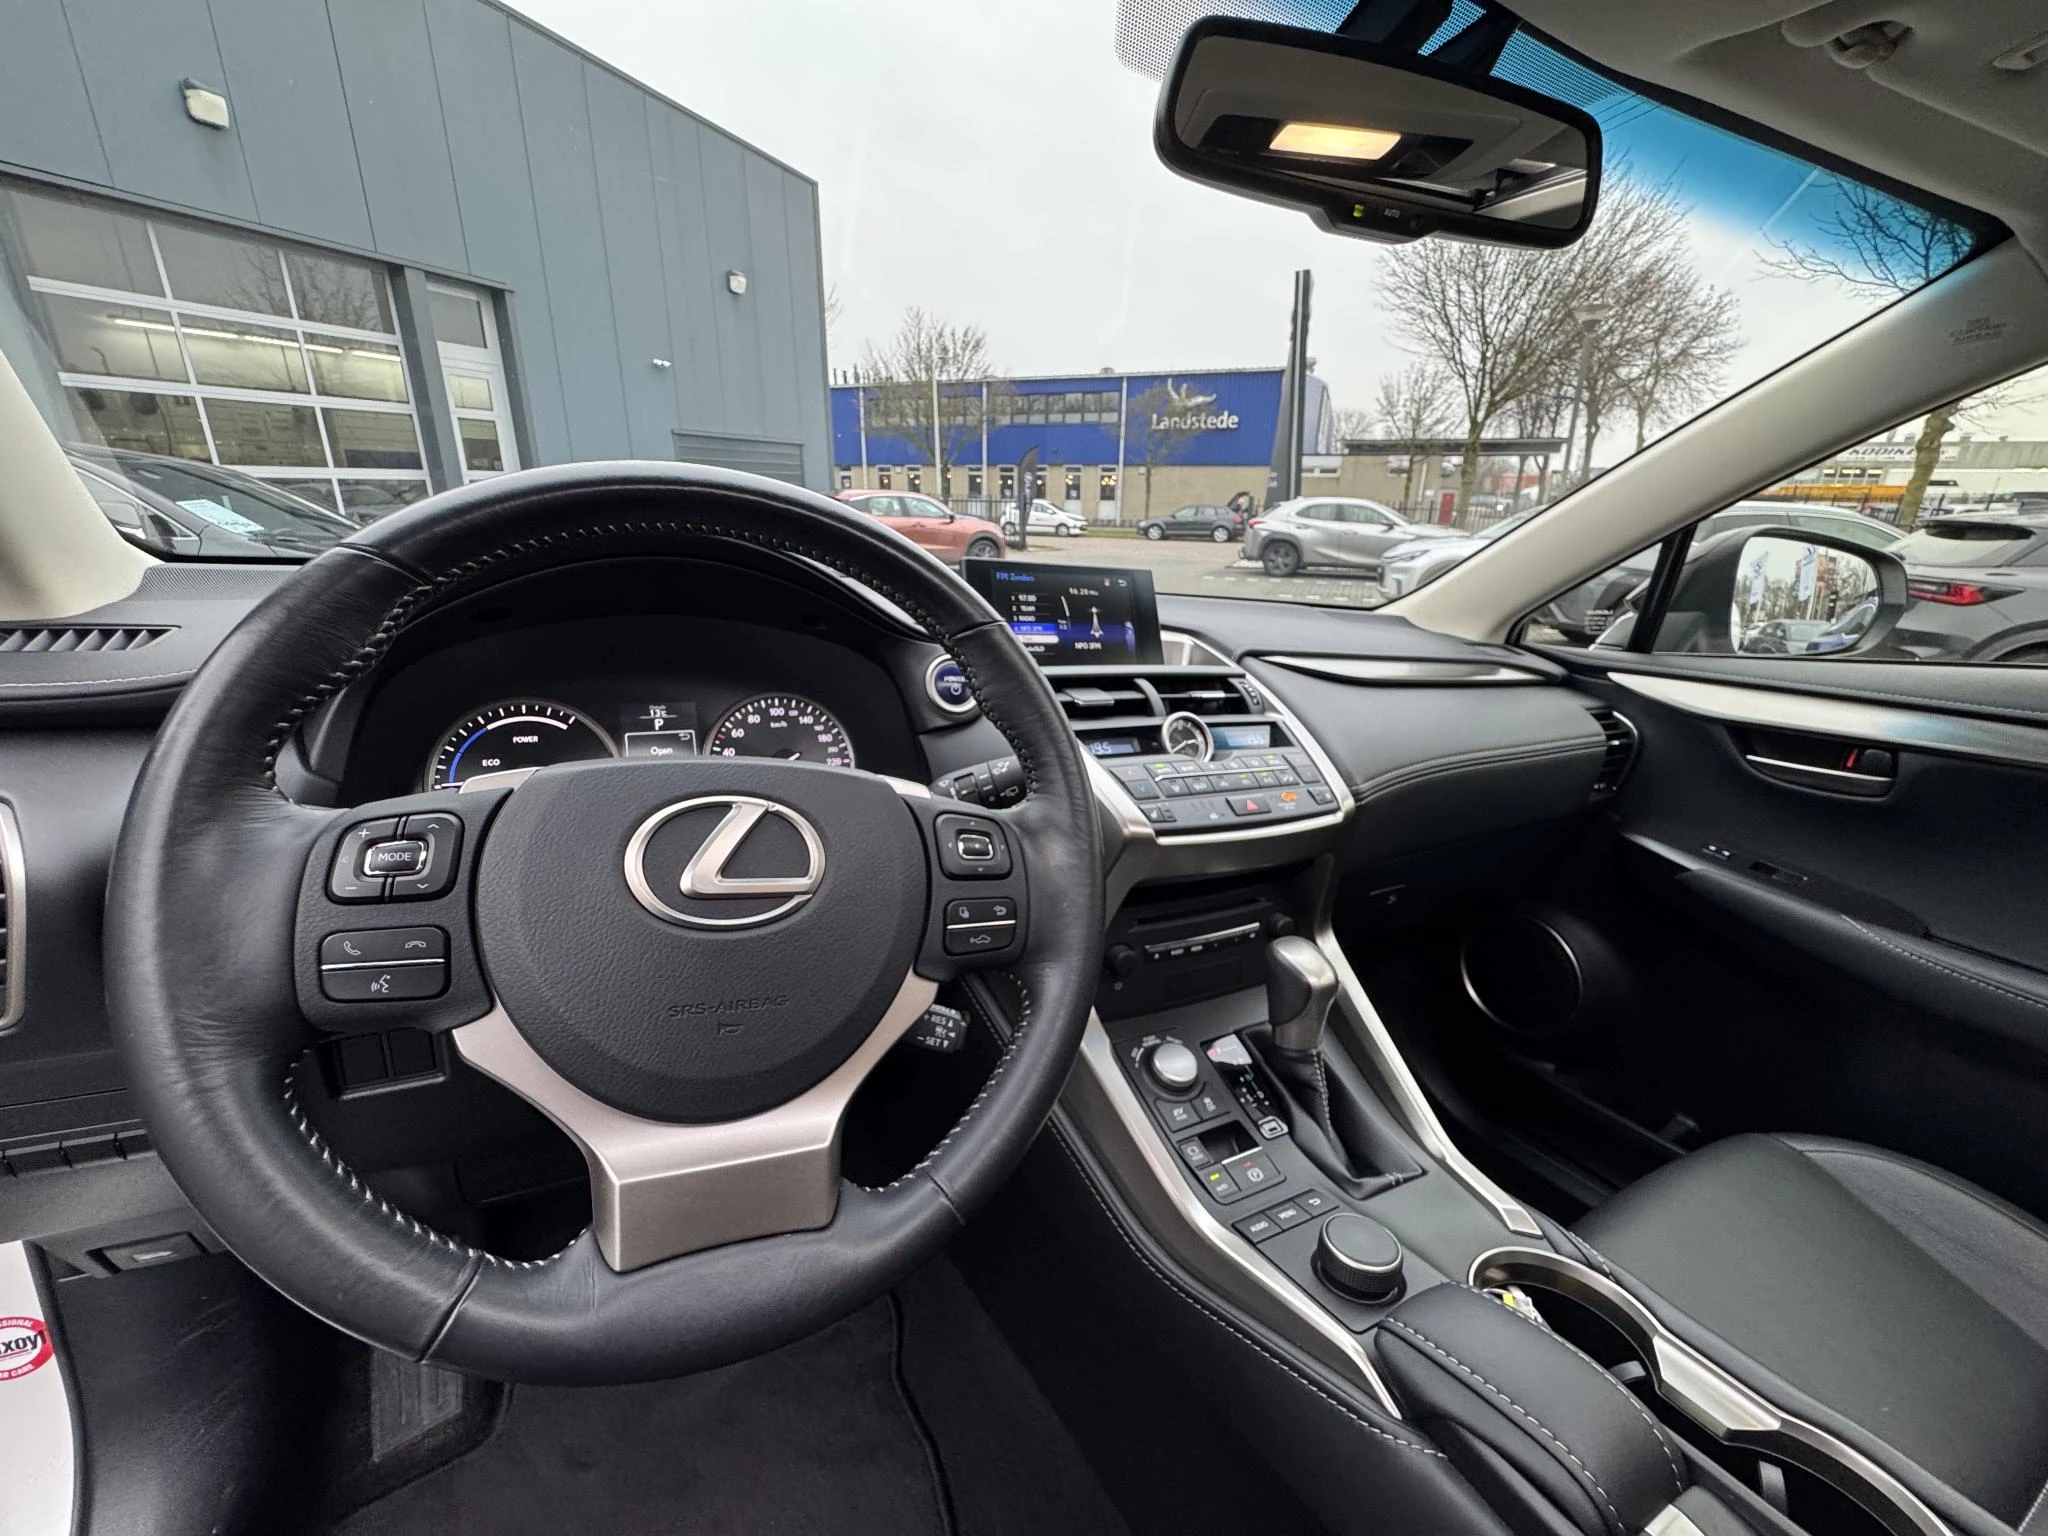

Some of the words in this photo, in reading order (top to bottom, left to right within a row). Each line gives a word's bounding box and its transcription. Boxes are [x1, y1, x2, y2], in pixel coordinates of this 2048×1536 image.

[1151, 410, 1239, 430] Landstede
[769, 707, 785, 717] 100
[747, 714, 760, 724] 80
[798, 716, 813, 724] 140
[654, 718, 664, 731] P
[731, 729, 744, 738] 60
[512, 735, 539, 744] POWER
[650, 746, 673, 756] Open
[722, 748, 735, 757] 40
[482, 758, 500, 767] ECO
[378, 852, 411, 862] MODE
[668, 995, 789, 1018] SRS-AIRBAG
